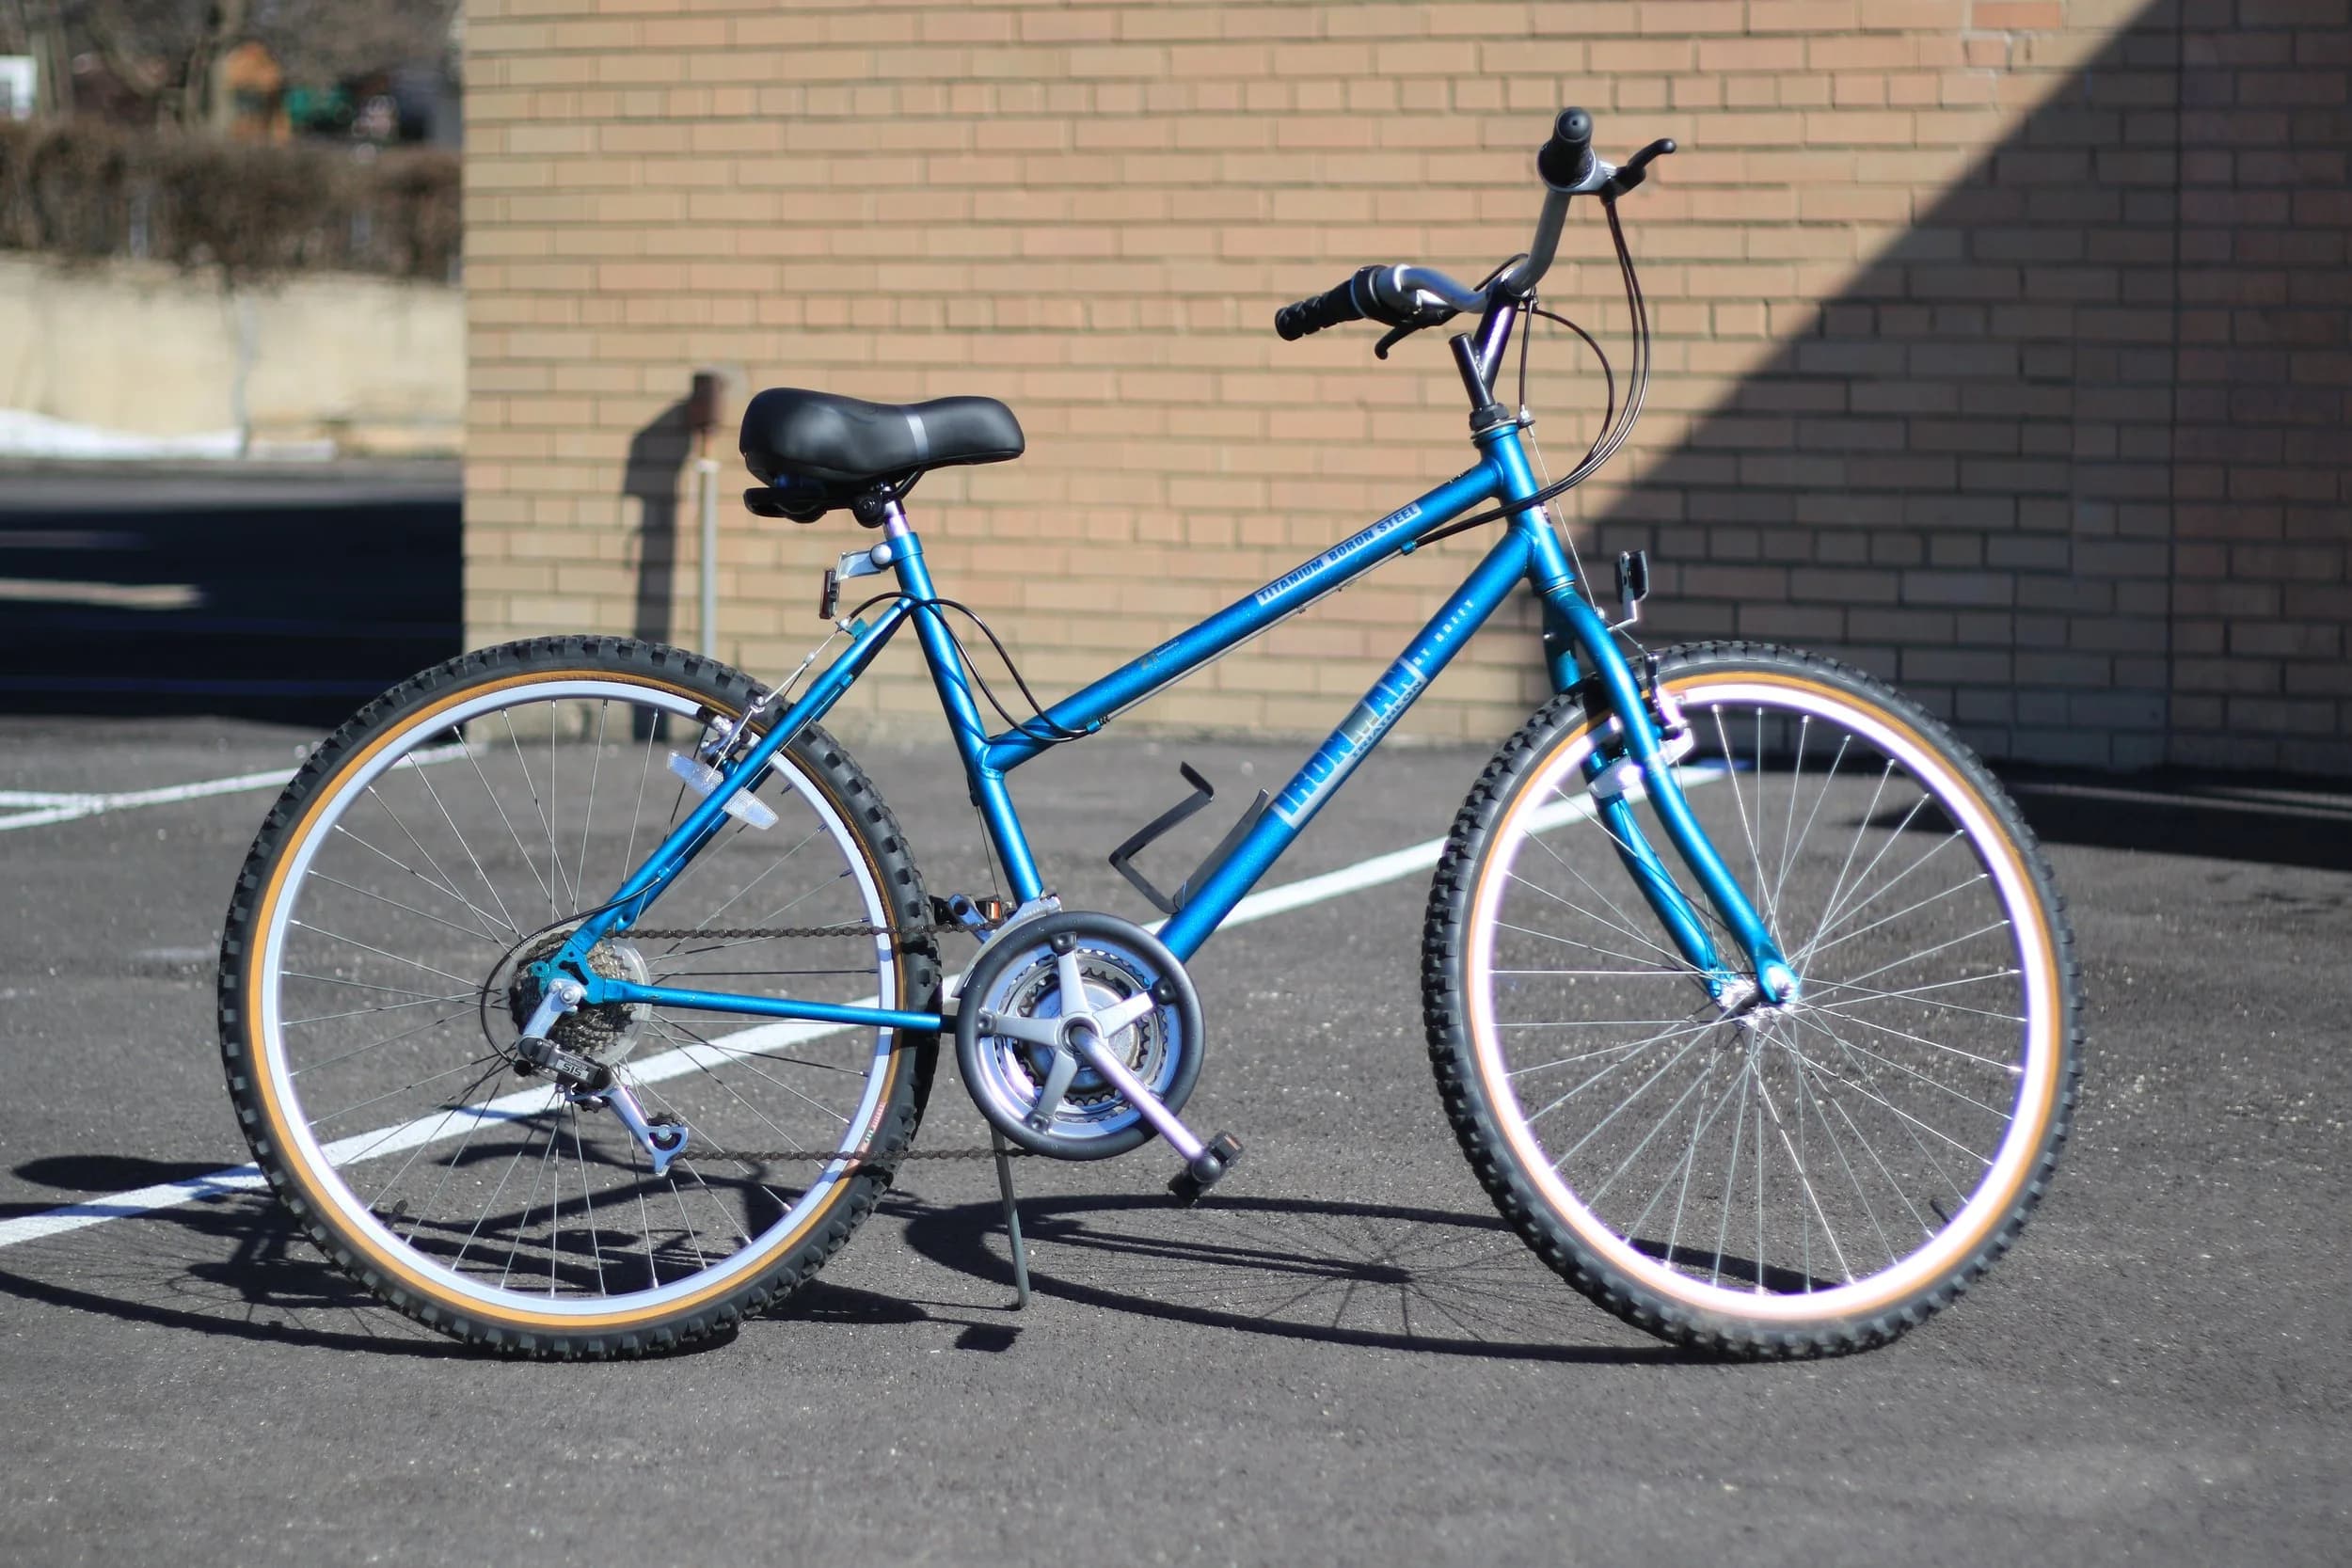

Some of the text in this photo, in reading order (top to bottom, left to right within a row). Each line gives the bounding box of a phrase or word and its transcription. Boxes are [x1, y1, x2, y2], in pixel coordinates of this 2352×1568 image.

[1257, 506, 1419, 602] TITANIUM BORON STEEL
[1412, 646, 1431, 667] BY
[1273, 660, 1417, 816] IRONMAN
[1352, 679, 1422, 759] TRIATHLON
